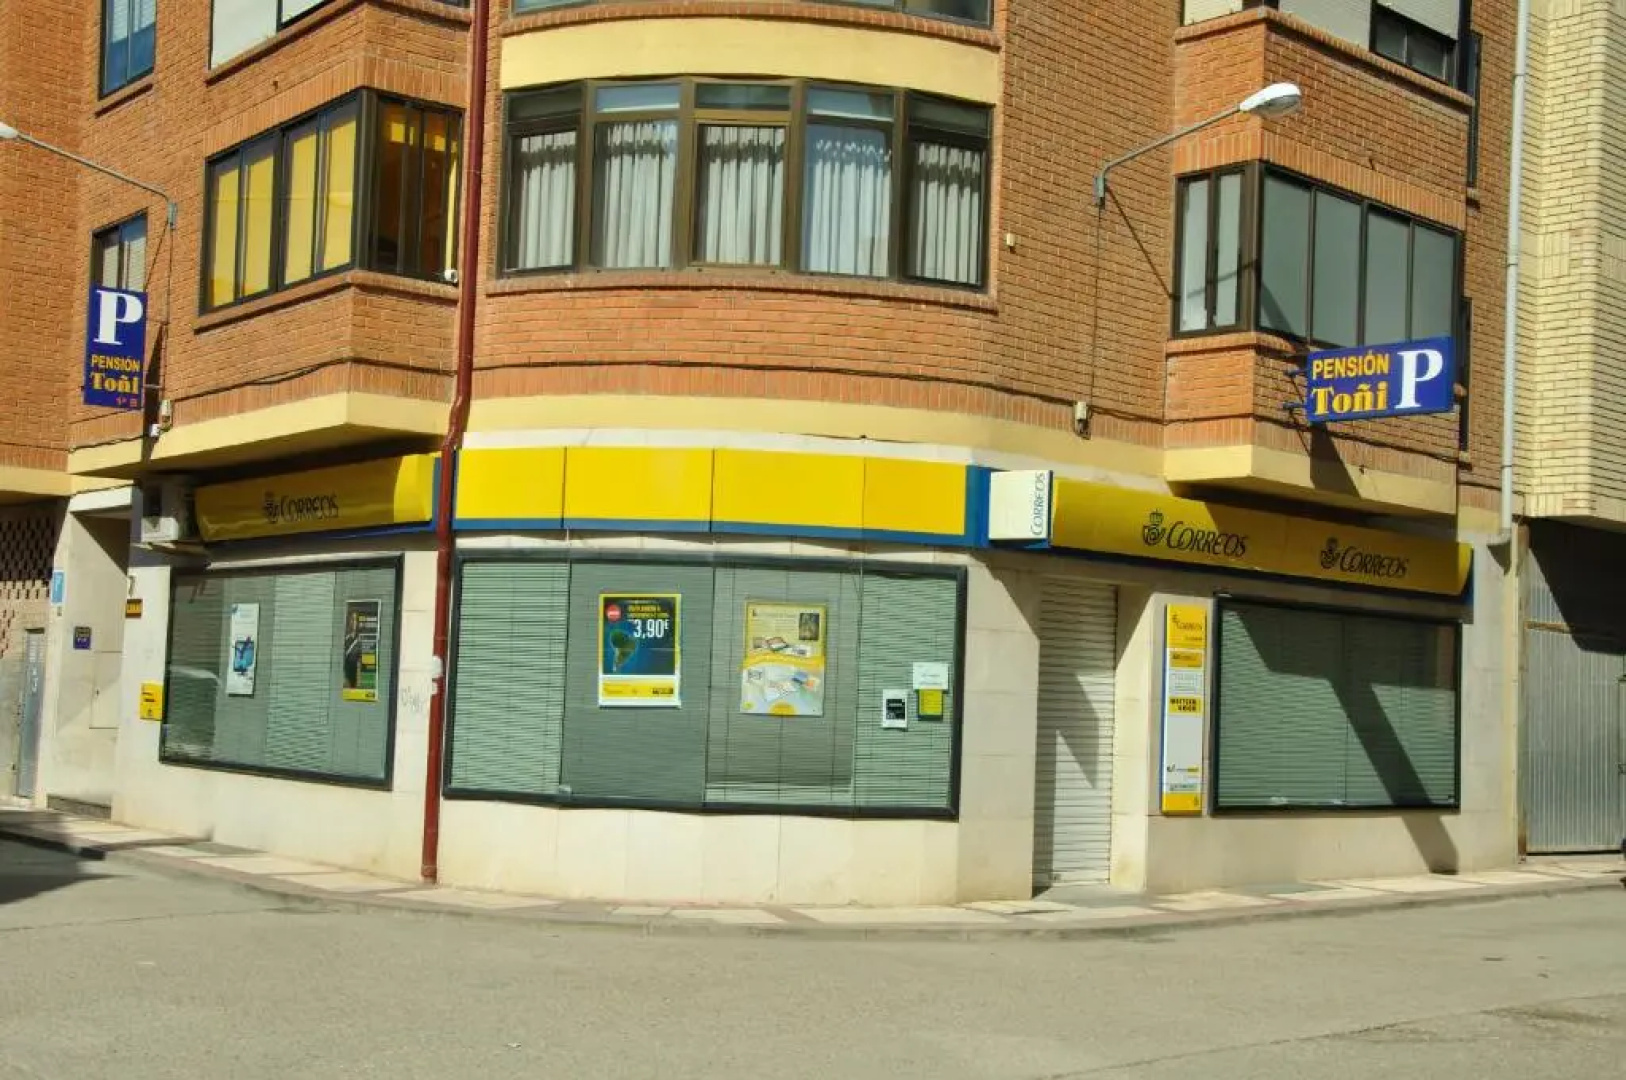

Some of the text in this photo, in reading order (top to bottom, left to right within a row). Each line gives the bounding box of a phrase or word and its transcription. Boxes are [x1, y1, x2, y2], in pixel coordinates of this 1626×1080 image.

[93, 289, 143, 345] P
[91, 353, 140, 372] PENSIÓN
[1311, 349, 1390, 381] PENSIÓN
[1394, 348, 1444, 409] P
[90, 371, 139, 395] Toñi
[1310, 380, 1389, 415] Toñi
[280, 494, 339, 522] CORREOS
[1031, 471, 1045, 536] CORREOS
[1166, 520, 1248, 558] CORREOS
[1339, 545, 1409, 579] CORREOS
